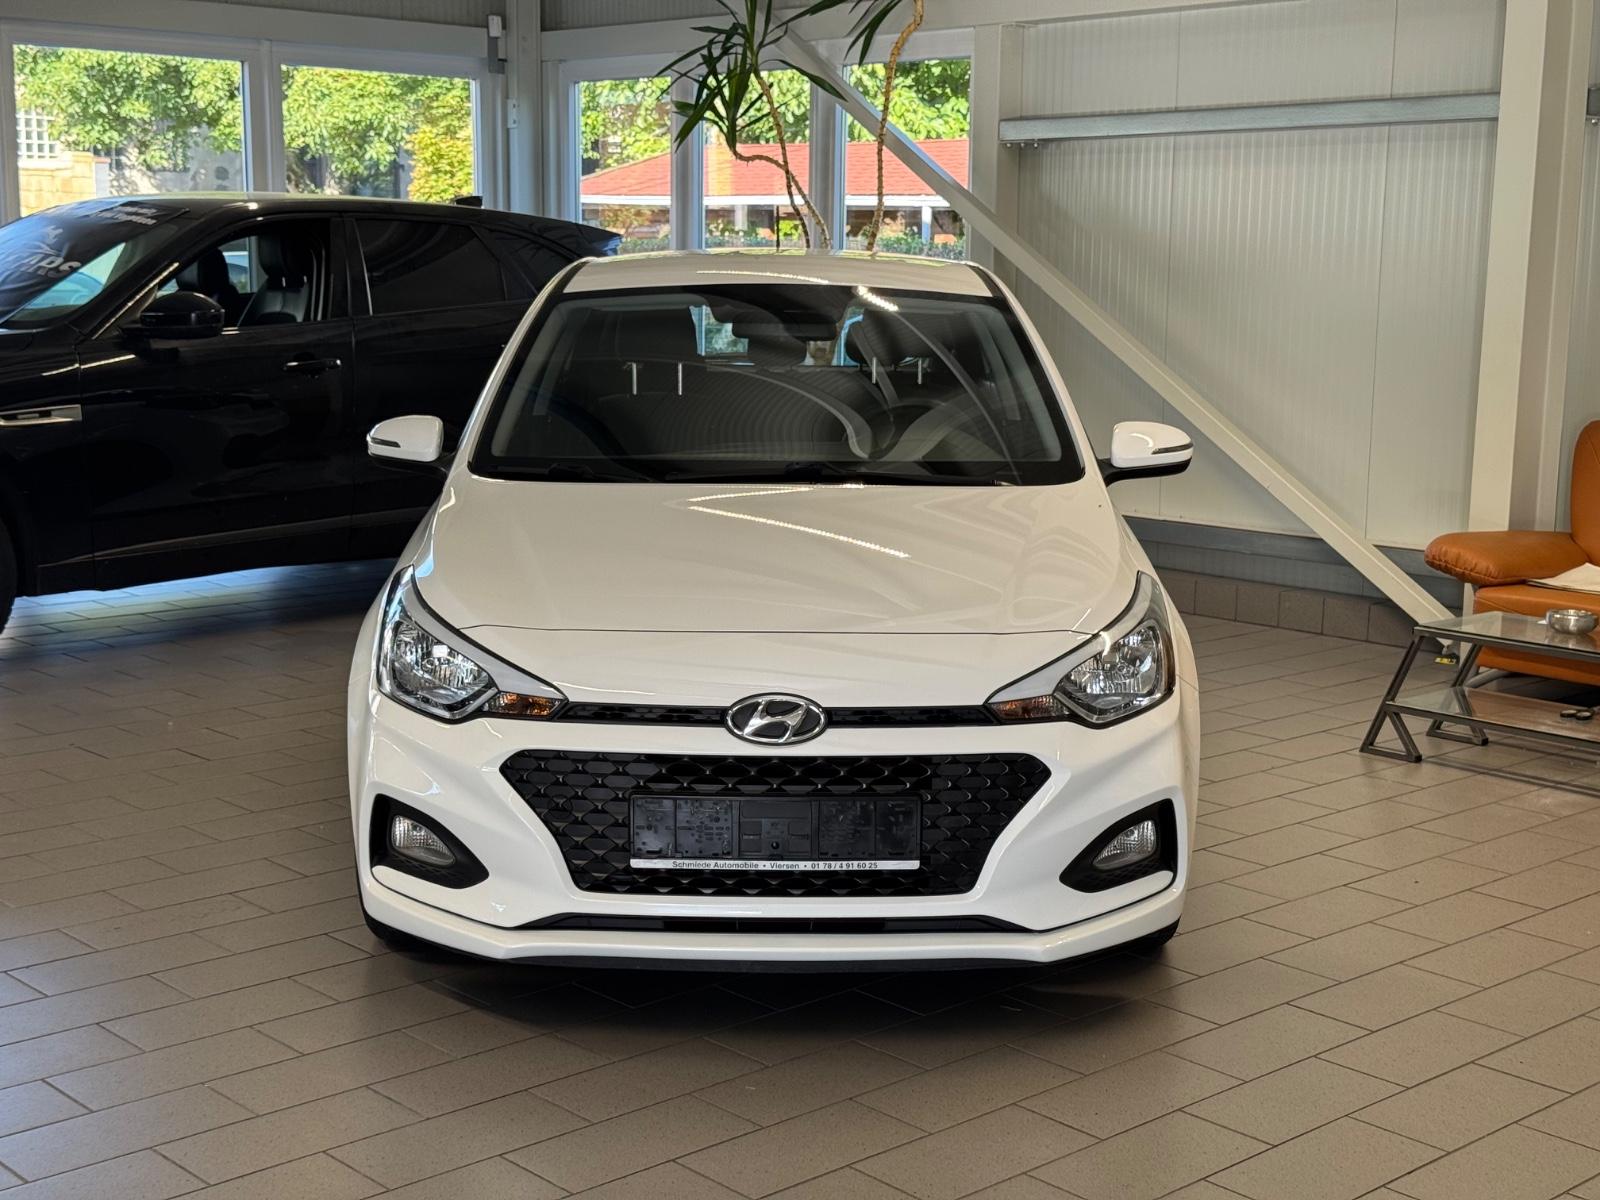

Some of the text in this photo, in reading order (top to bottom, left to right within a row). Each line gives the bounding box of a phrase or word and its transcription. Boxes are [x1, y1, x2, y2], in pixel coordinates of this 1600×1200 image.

[671, 860, 711, 868] Schmiede
[713, 861, 759, 869] Automobile
[769, 861, 800, 869] Viersen
